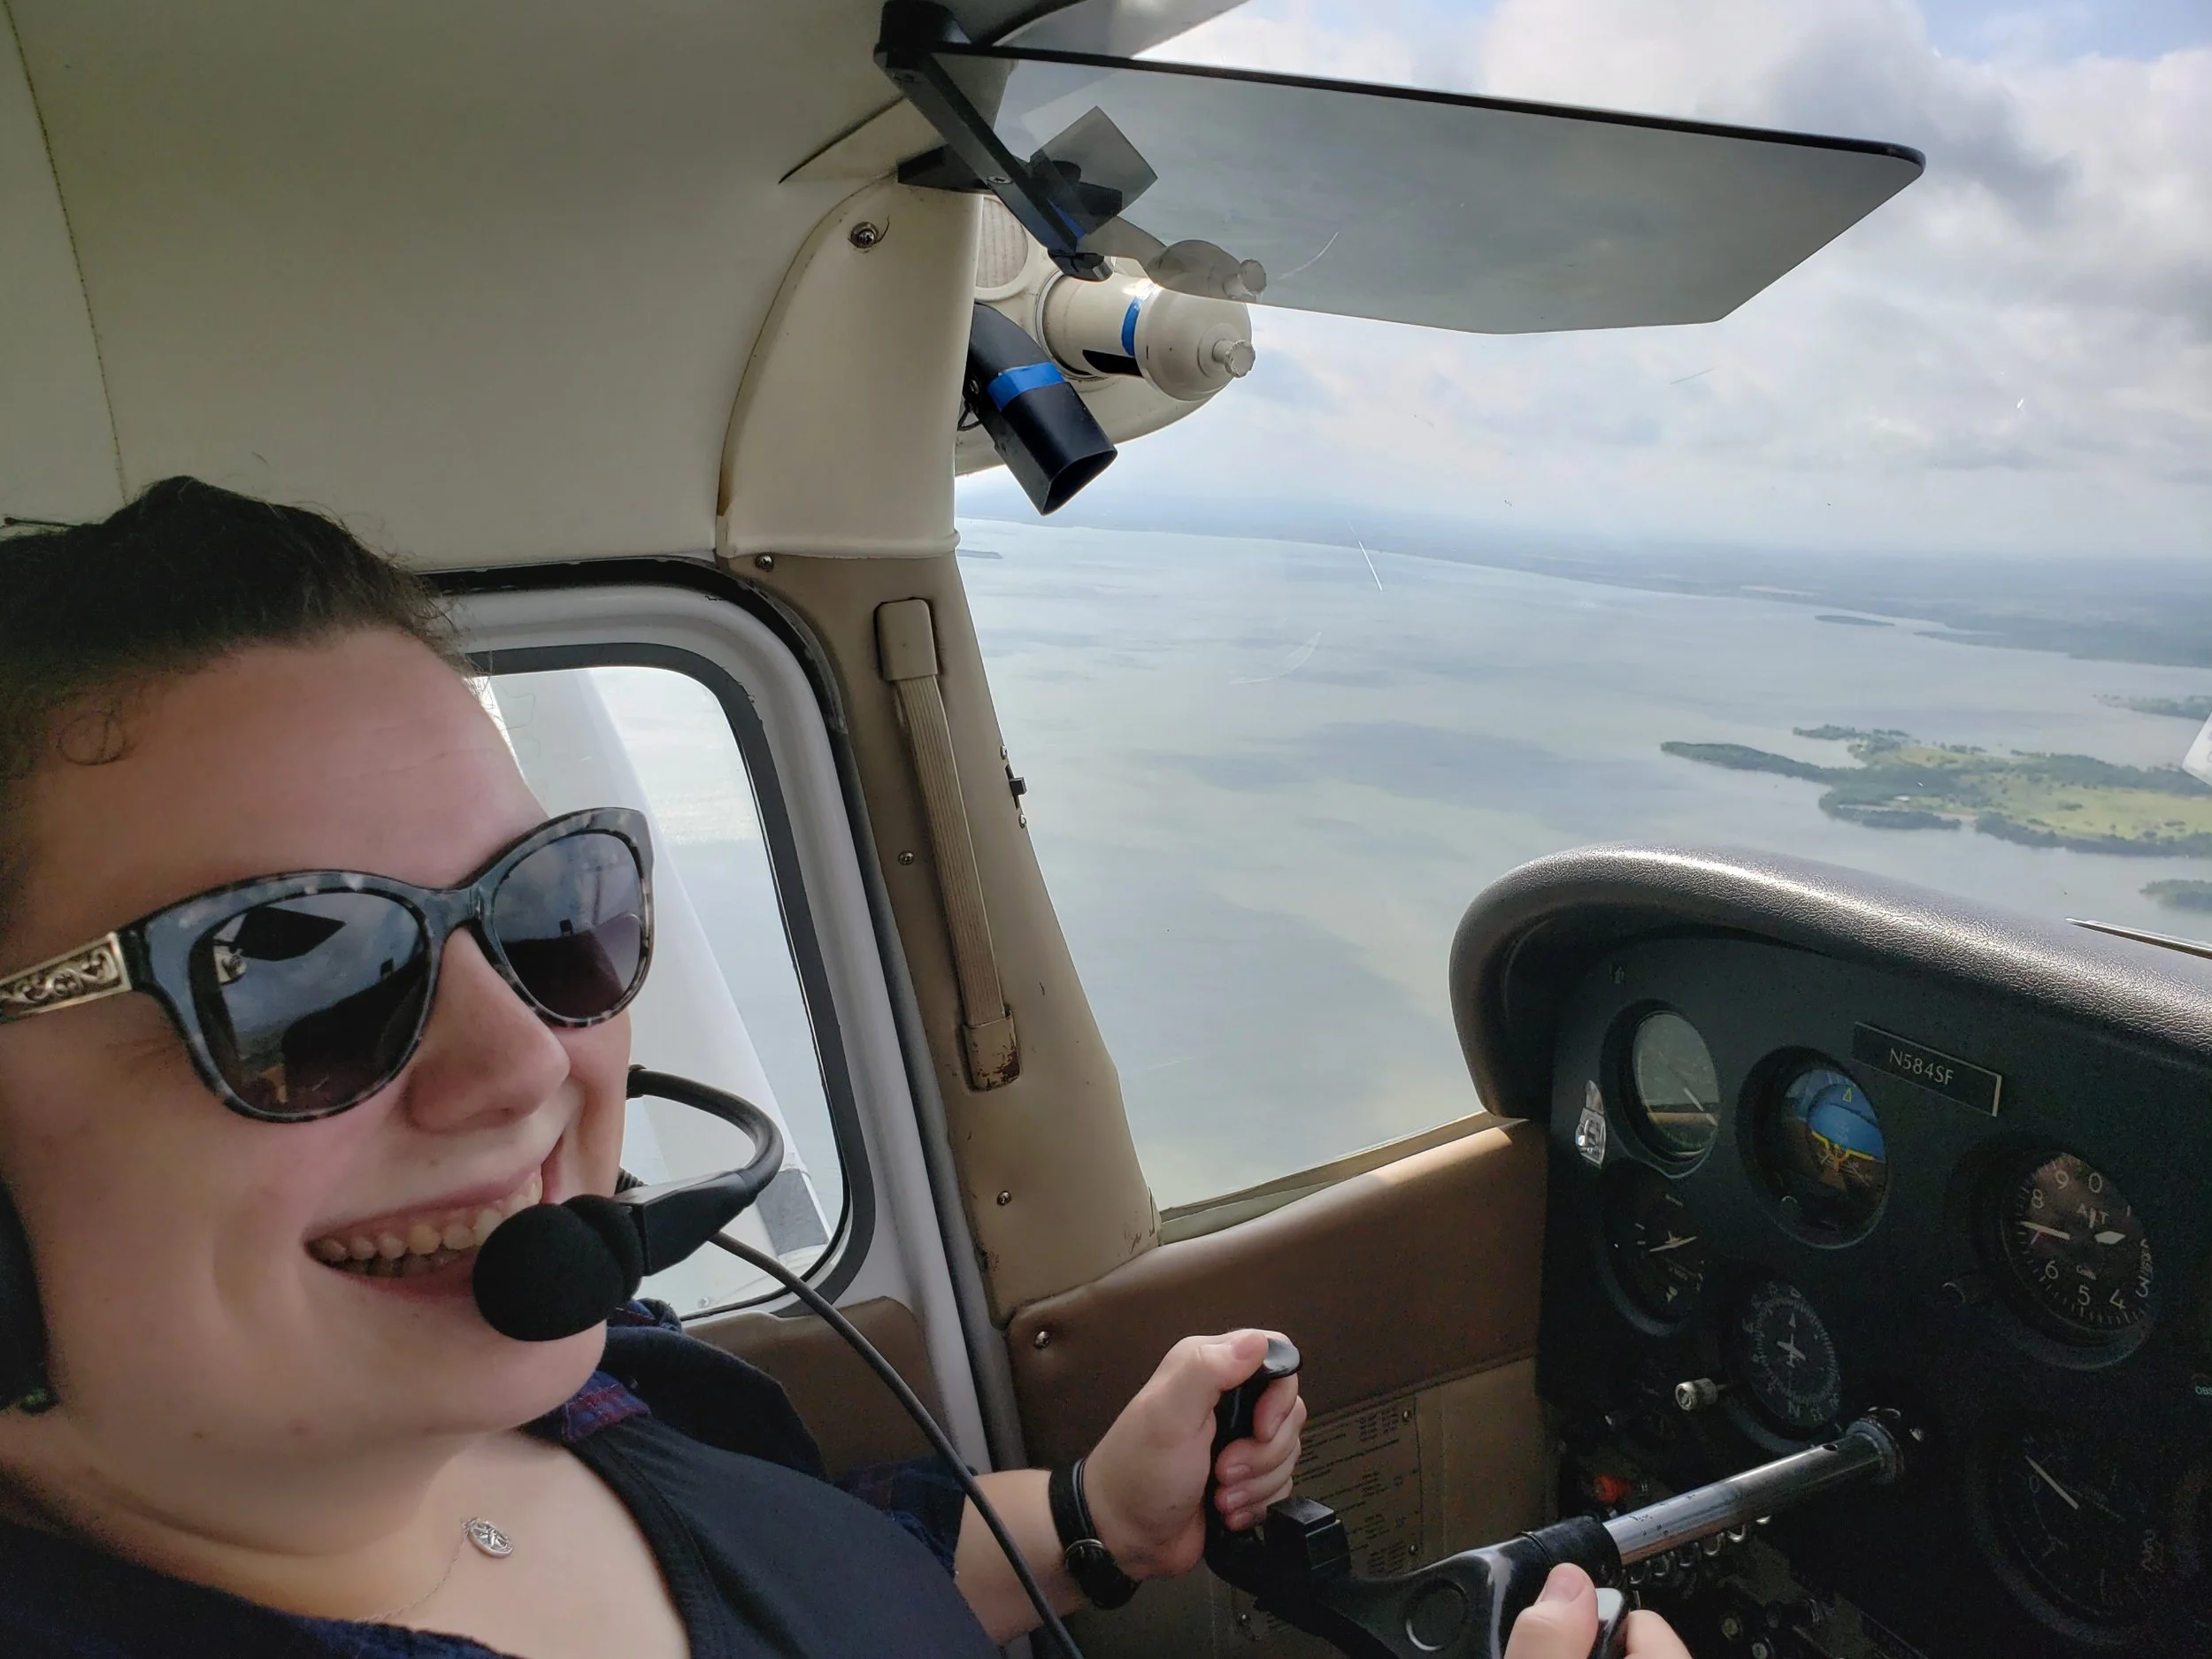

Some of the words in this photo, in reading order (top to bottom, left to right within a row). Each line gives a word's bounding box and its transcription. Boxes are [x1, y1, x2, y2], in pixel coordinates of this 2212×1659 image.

[1889, 1048, 1954, 1085] N584SF
[2055, 1171, 2069, 1189] 9
[2088, 1172, 2102, 1194] 0
[2031, 1188, 2044, 1210] 8
[2045, 1260, 2059, 1279] 6
[2078, 1284, 2090, 1306] 5
[2109, 1289, 2125, 1310] 4
